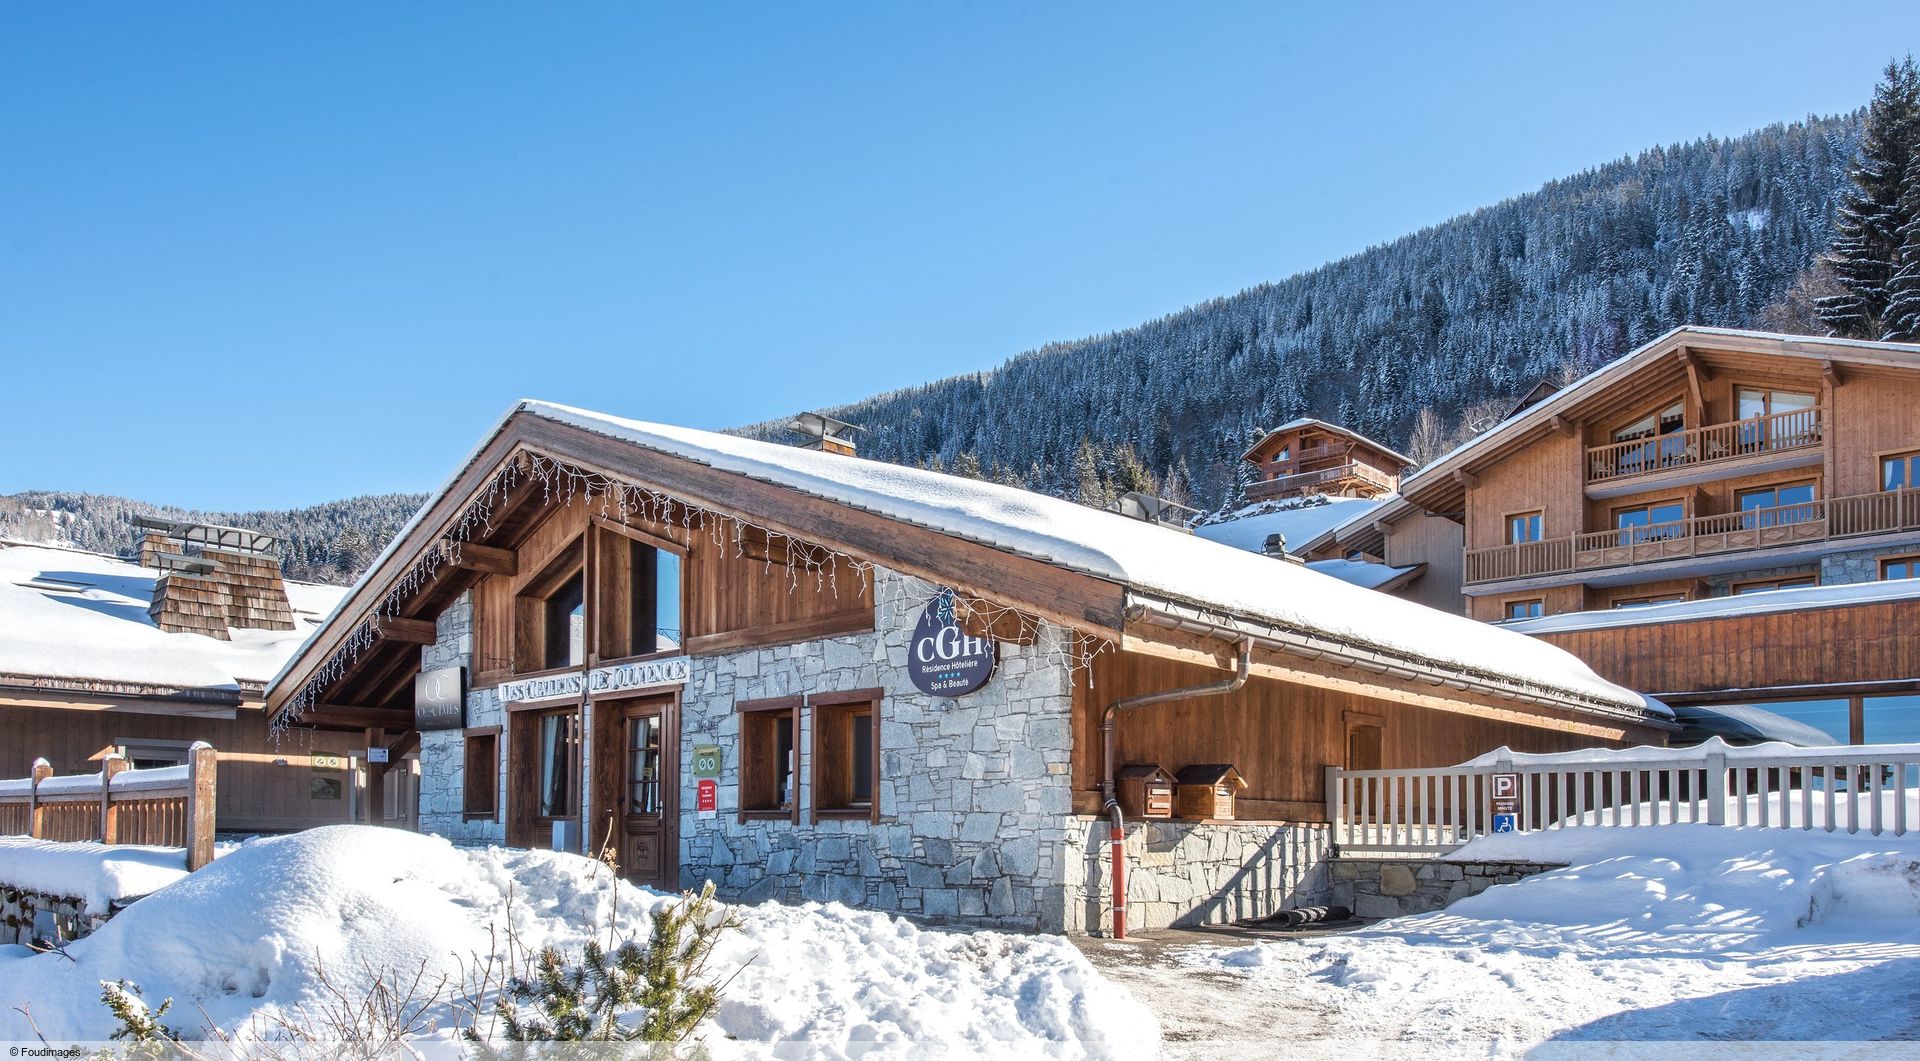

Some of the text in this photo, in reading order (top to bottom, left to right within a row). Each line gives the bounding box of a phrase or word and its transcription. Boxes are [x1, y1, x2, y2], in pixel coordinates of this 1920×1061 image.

[917, 626, 983, 663] CGH
[922, 660, 978, 673] Résidence Hôtelière
[502, 683, 524, 701] LES
[589, 671, 609, 690] DE
[930, 681, 942, 691] Spa
[949, 678, 969, 688] Beauté
[1498, 778, 1512, 796] P
